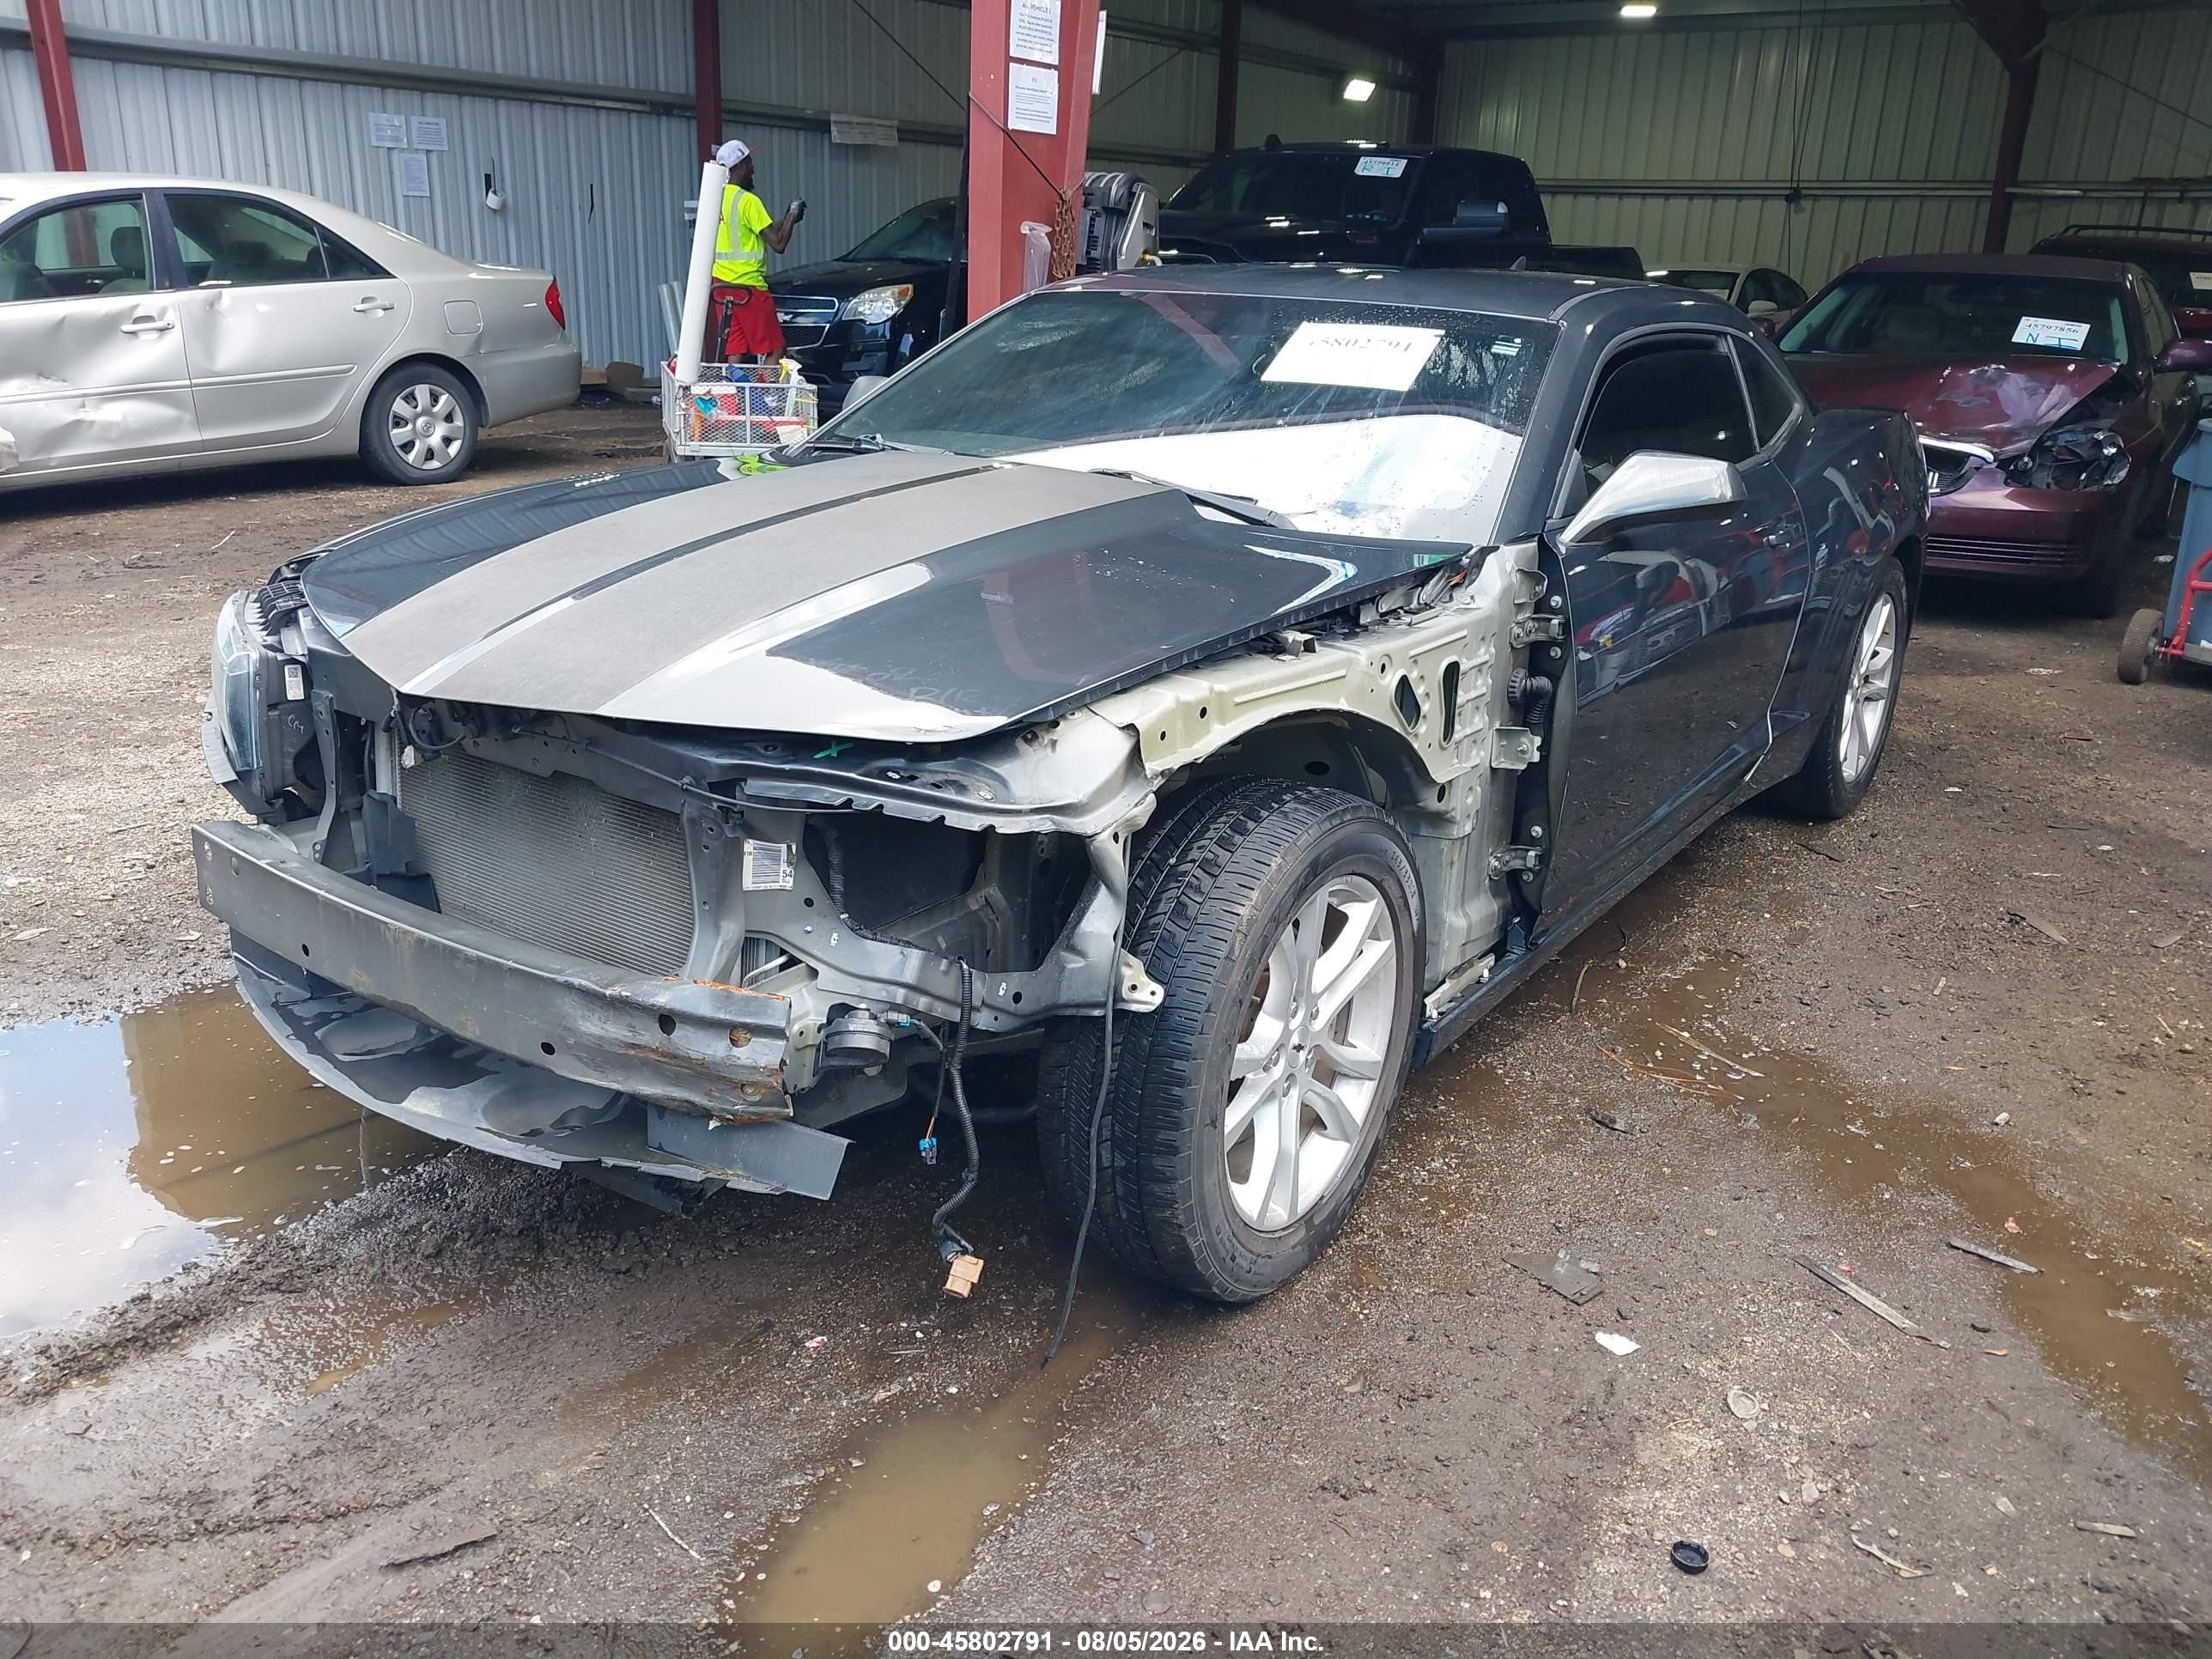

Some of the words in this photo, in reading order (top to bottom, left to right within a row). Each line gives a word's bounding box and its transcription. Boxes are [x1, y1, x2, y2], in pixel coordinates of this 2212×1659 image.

[2027, 323, 2079, 333] 45797856
[2027, 332, 2040, 343] N
[782, 869, 793, 878] 54
